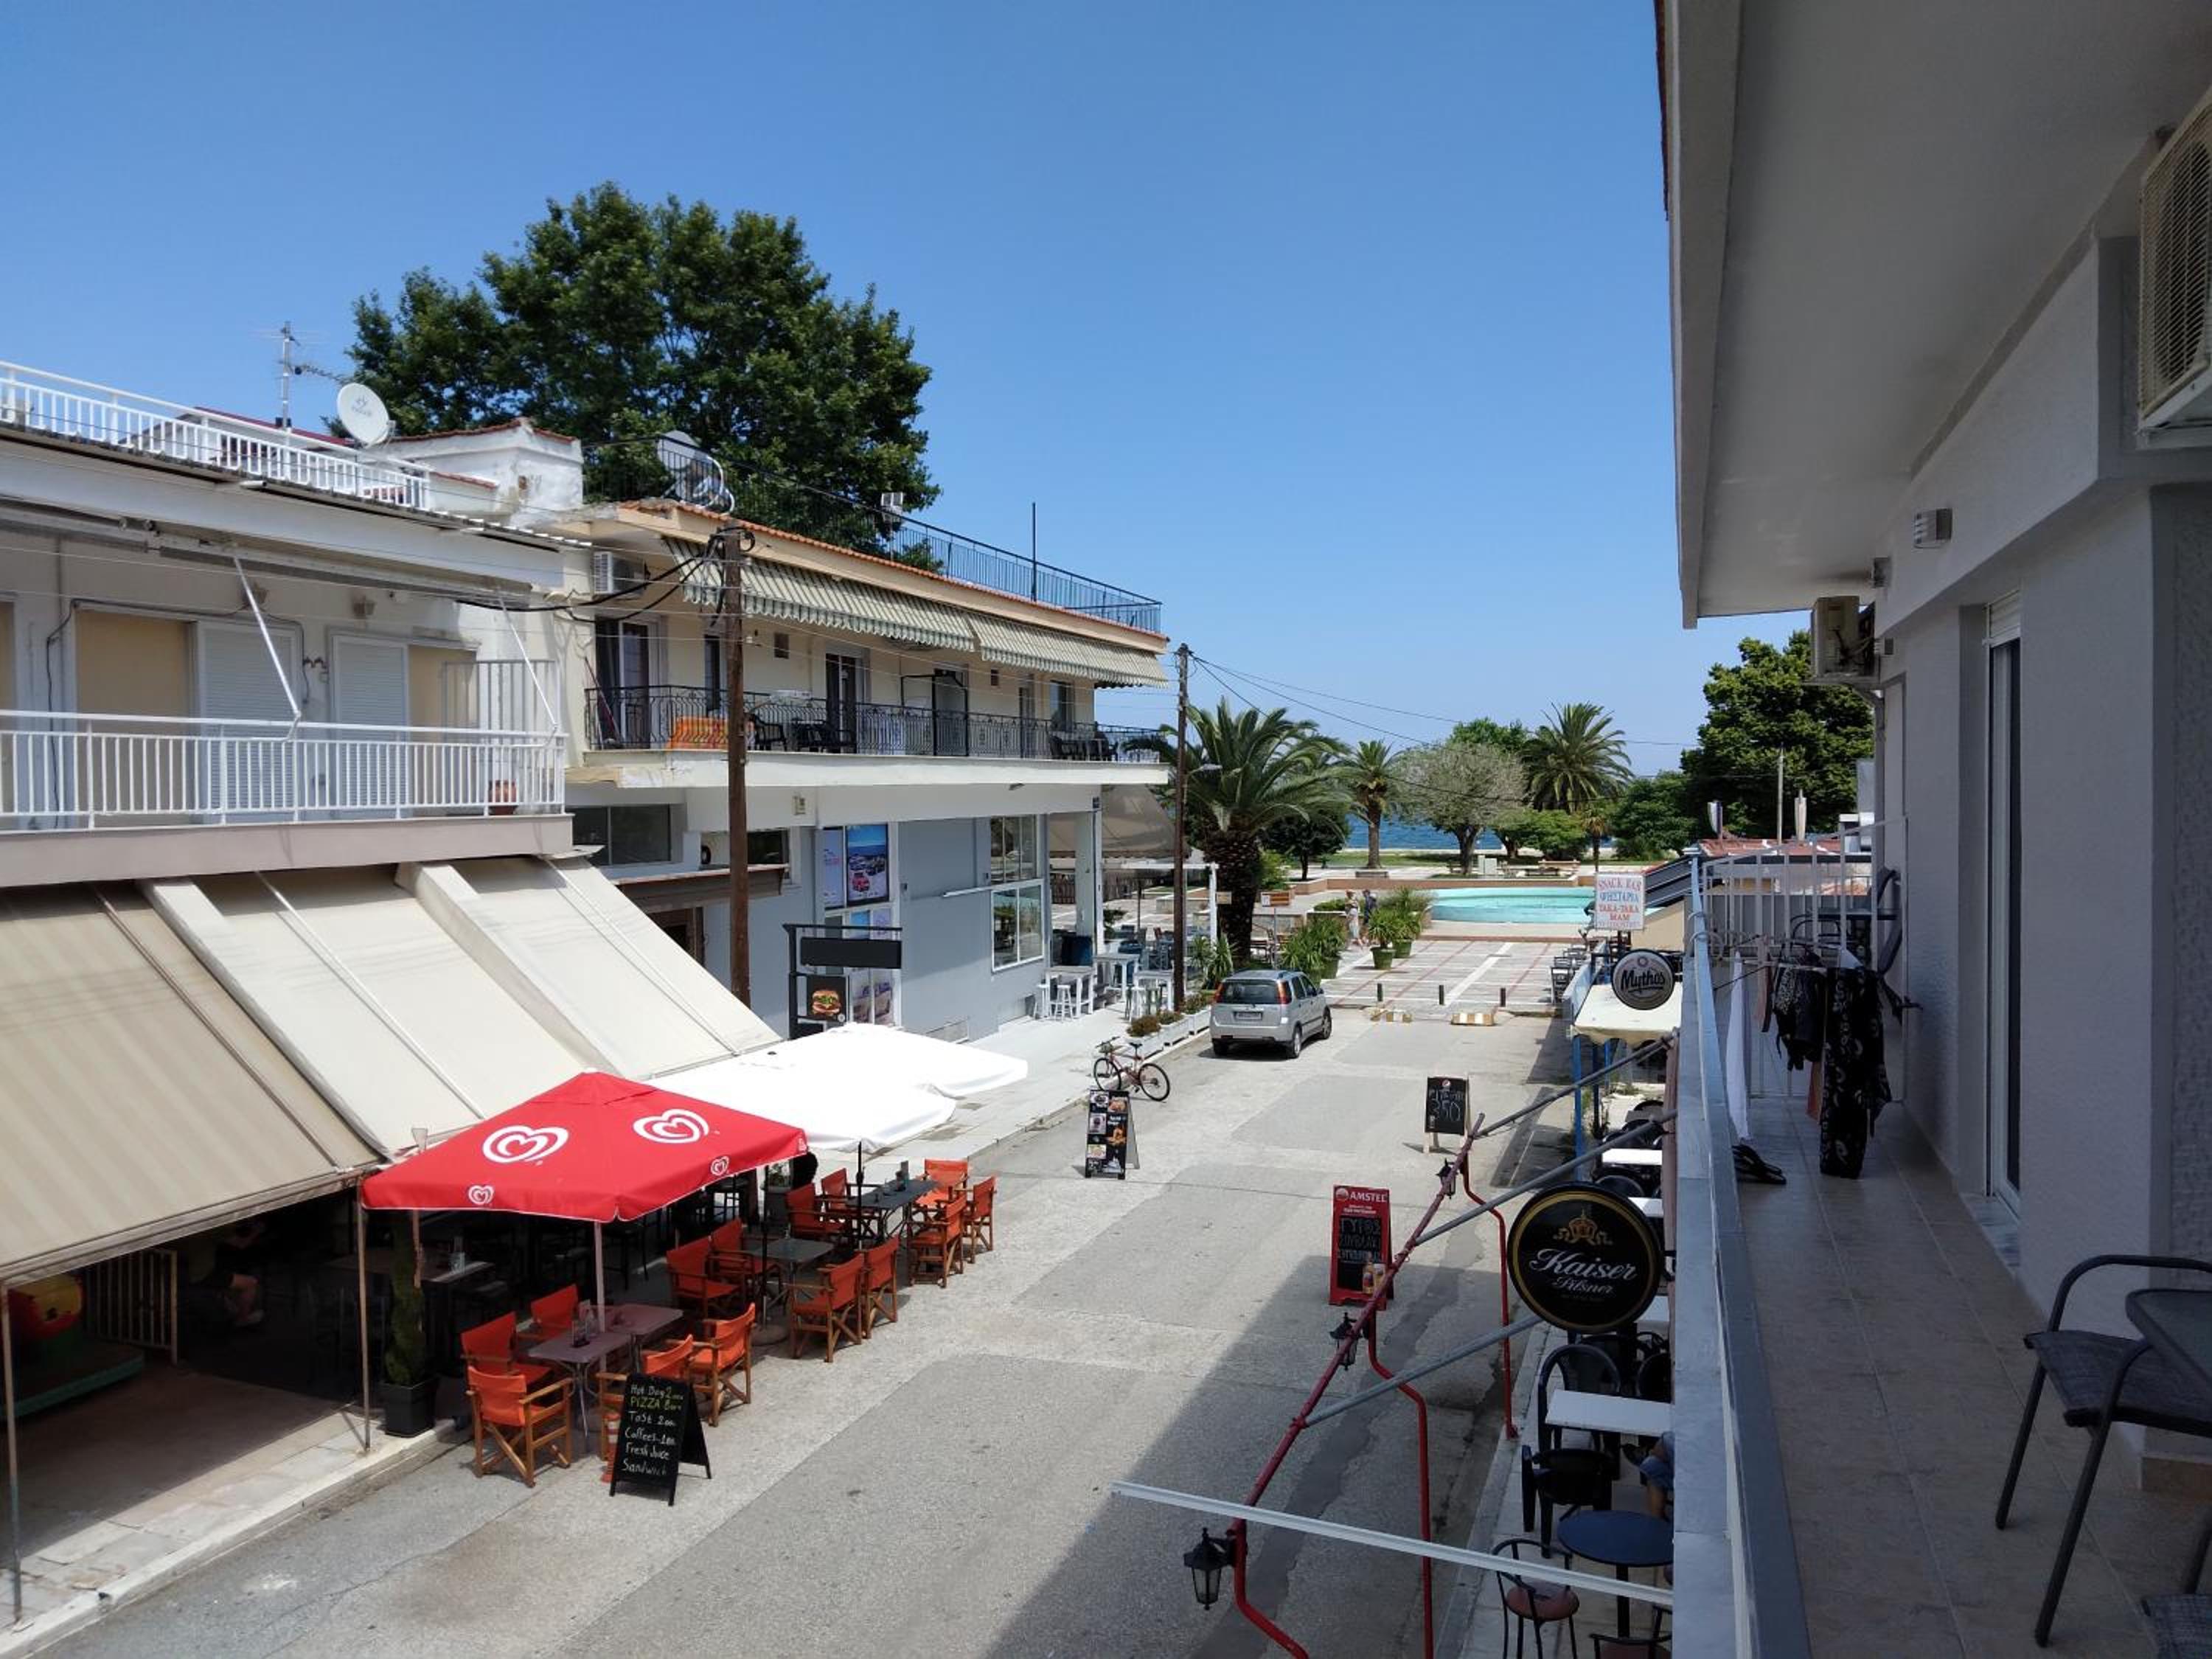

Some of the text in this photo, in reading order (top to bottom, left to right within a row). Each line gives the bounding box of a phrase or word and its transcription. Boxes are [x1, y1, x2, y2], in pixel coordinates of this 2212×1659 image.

[1620, 970, 1666, 993] Mythos
[1350, 1192, 1387, 1203] AMSTEL
[1529, 1248, 1638, 1280] Kaiser
[1551, 1276, 1614, 1293] Pilsner
[630, 1396, 661, 1408] PIZZA
